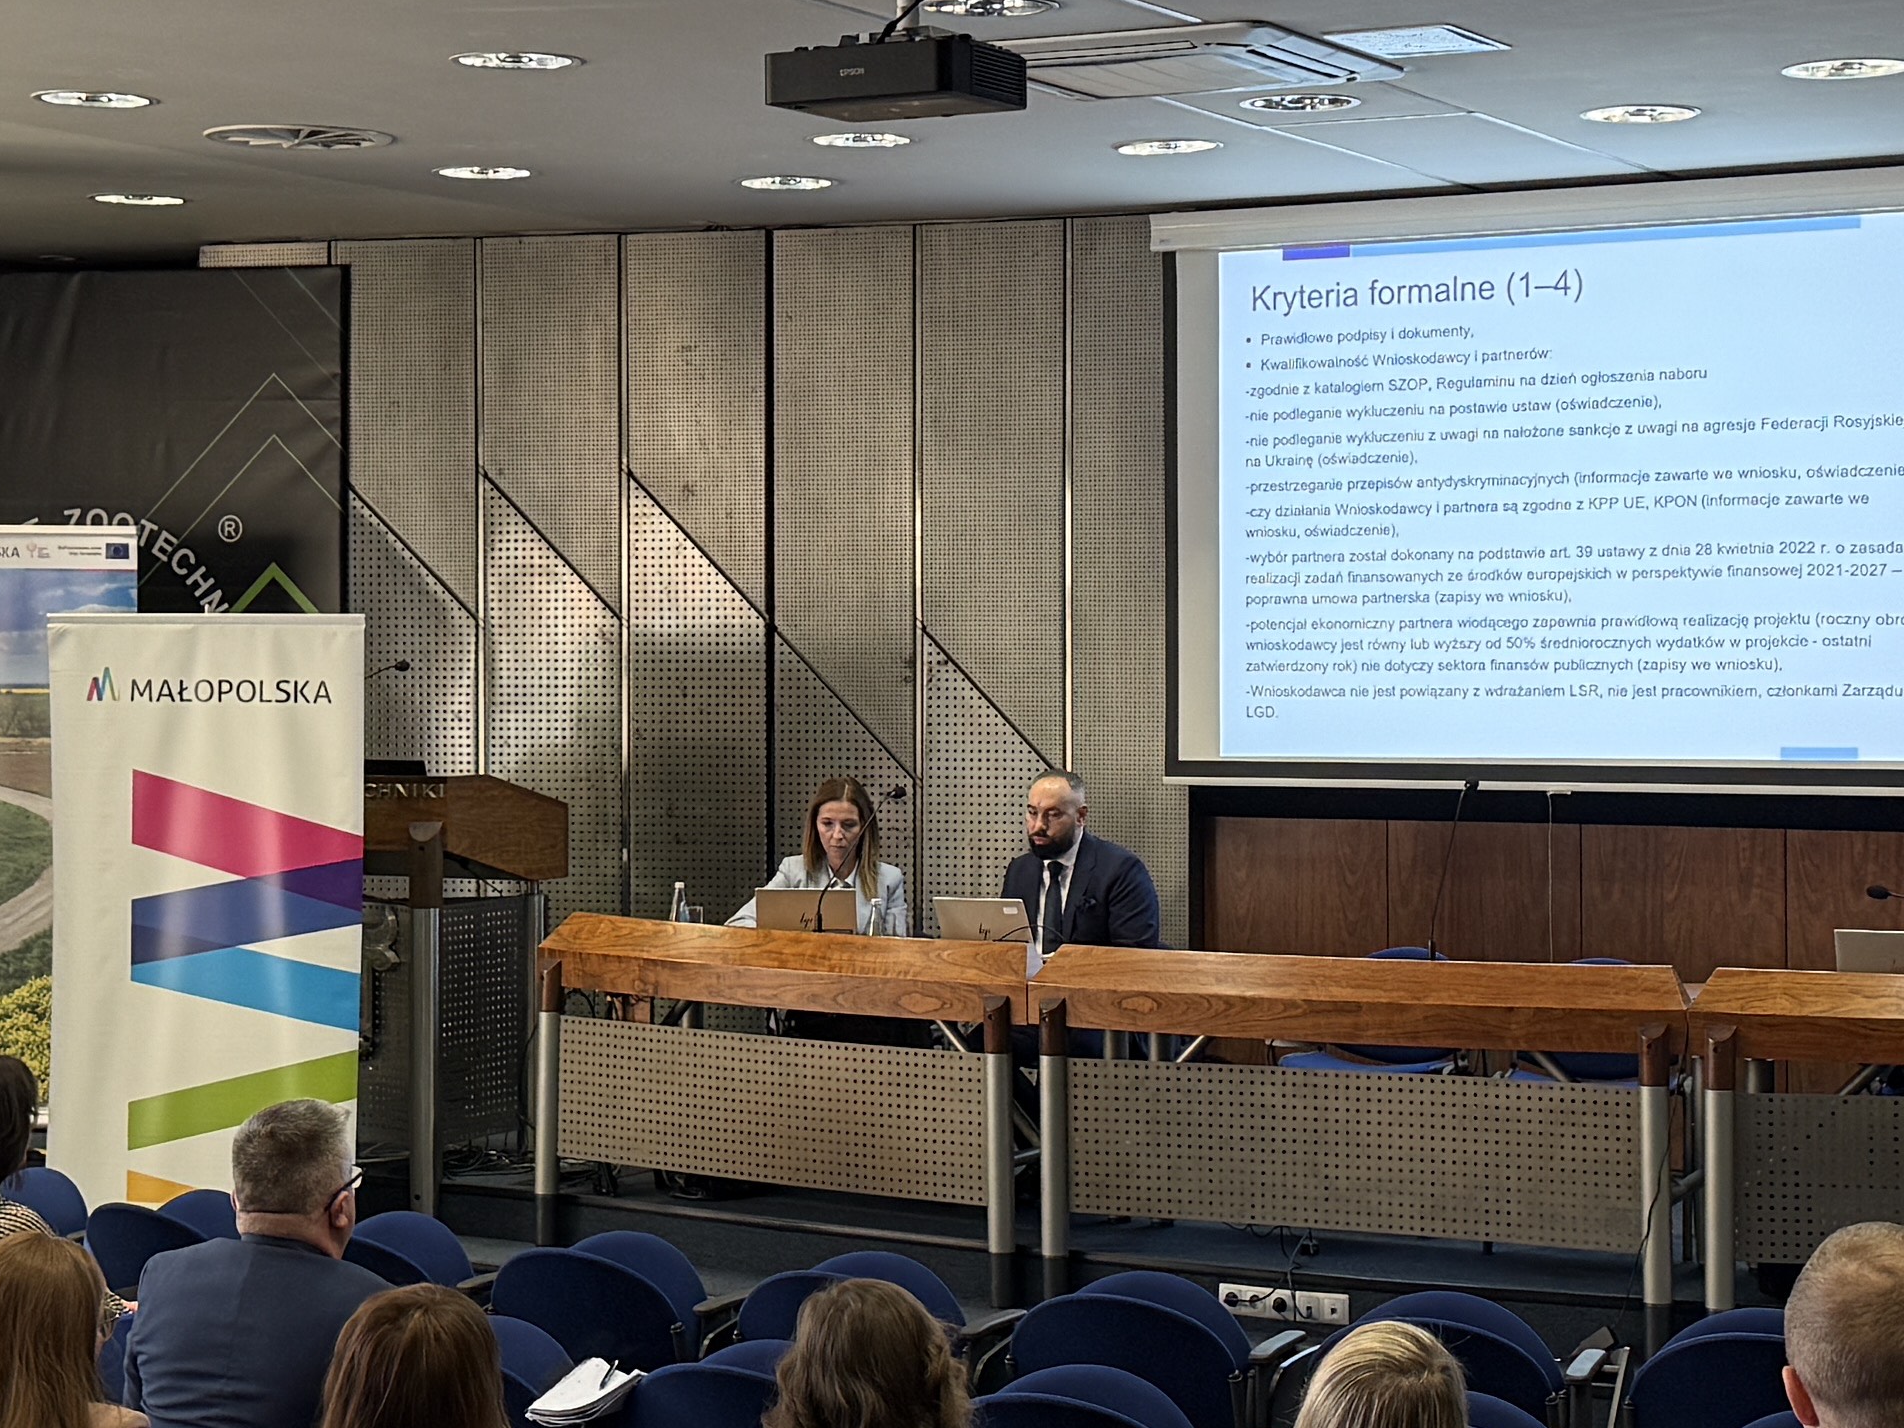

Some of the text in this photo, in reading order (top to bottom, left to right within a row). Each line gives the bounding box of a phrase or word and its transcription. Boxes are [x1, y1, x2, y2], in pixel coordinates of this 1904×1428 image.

[1252, 268, 1582, 317] Kryteria formalne (1–4)
[1519, 376, 1536, 386] na
[1429, 405, 1445, 415] na
[1483, 429, 1498, 439] na
[1681, 422, 1698, 433] na
[1245, 457, 1260, 467] na
[1712, 469, 1732, 480] we
[1502, 502, 1518, 515] są
[1588, 496, 1619, 510] KPP
[1847, 494, 1869, 505] we
[1457, 550, 1474, 560] na
[1575, 545, 1592, 558] 39
[1695, 542, 1712, 556] 28
[1447, 571, 1463, 582] ze
[1484, 592, 1504, 602] we
[1410, 637, 1429, 650] lub
[1485, 636, 1501, 650] od
[1506, 636, 1535, 649] 50%
[1361, 659, 1380, 671] nie
[1690, 661, 1711, 671] we
[130, 678, 332, 704] MAŁOPOLSKA
[1350, 685, 1369, 697] nie
[1607, 684, 1628, 697] nie
